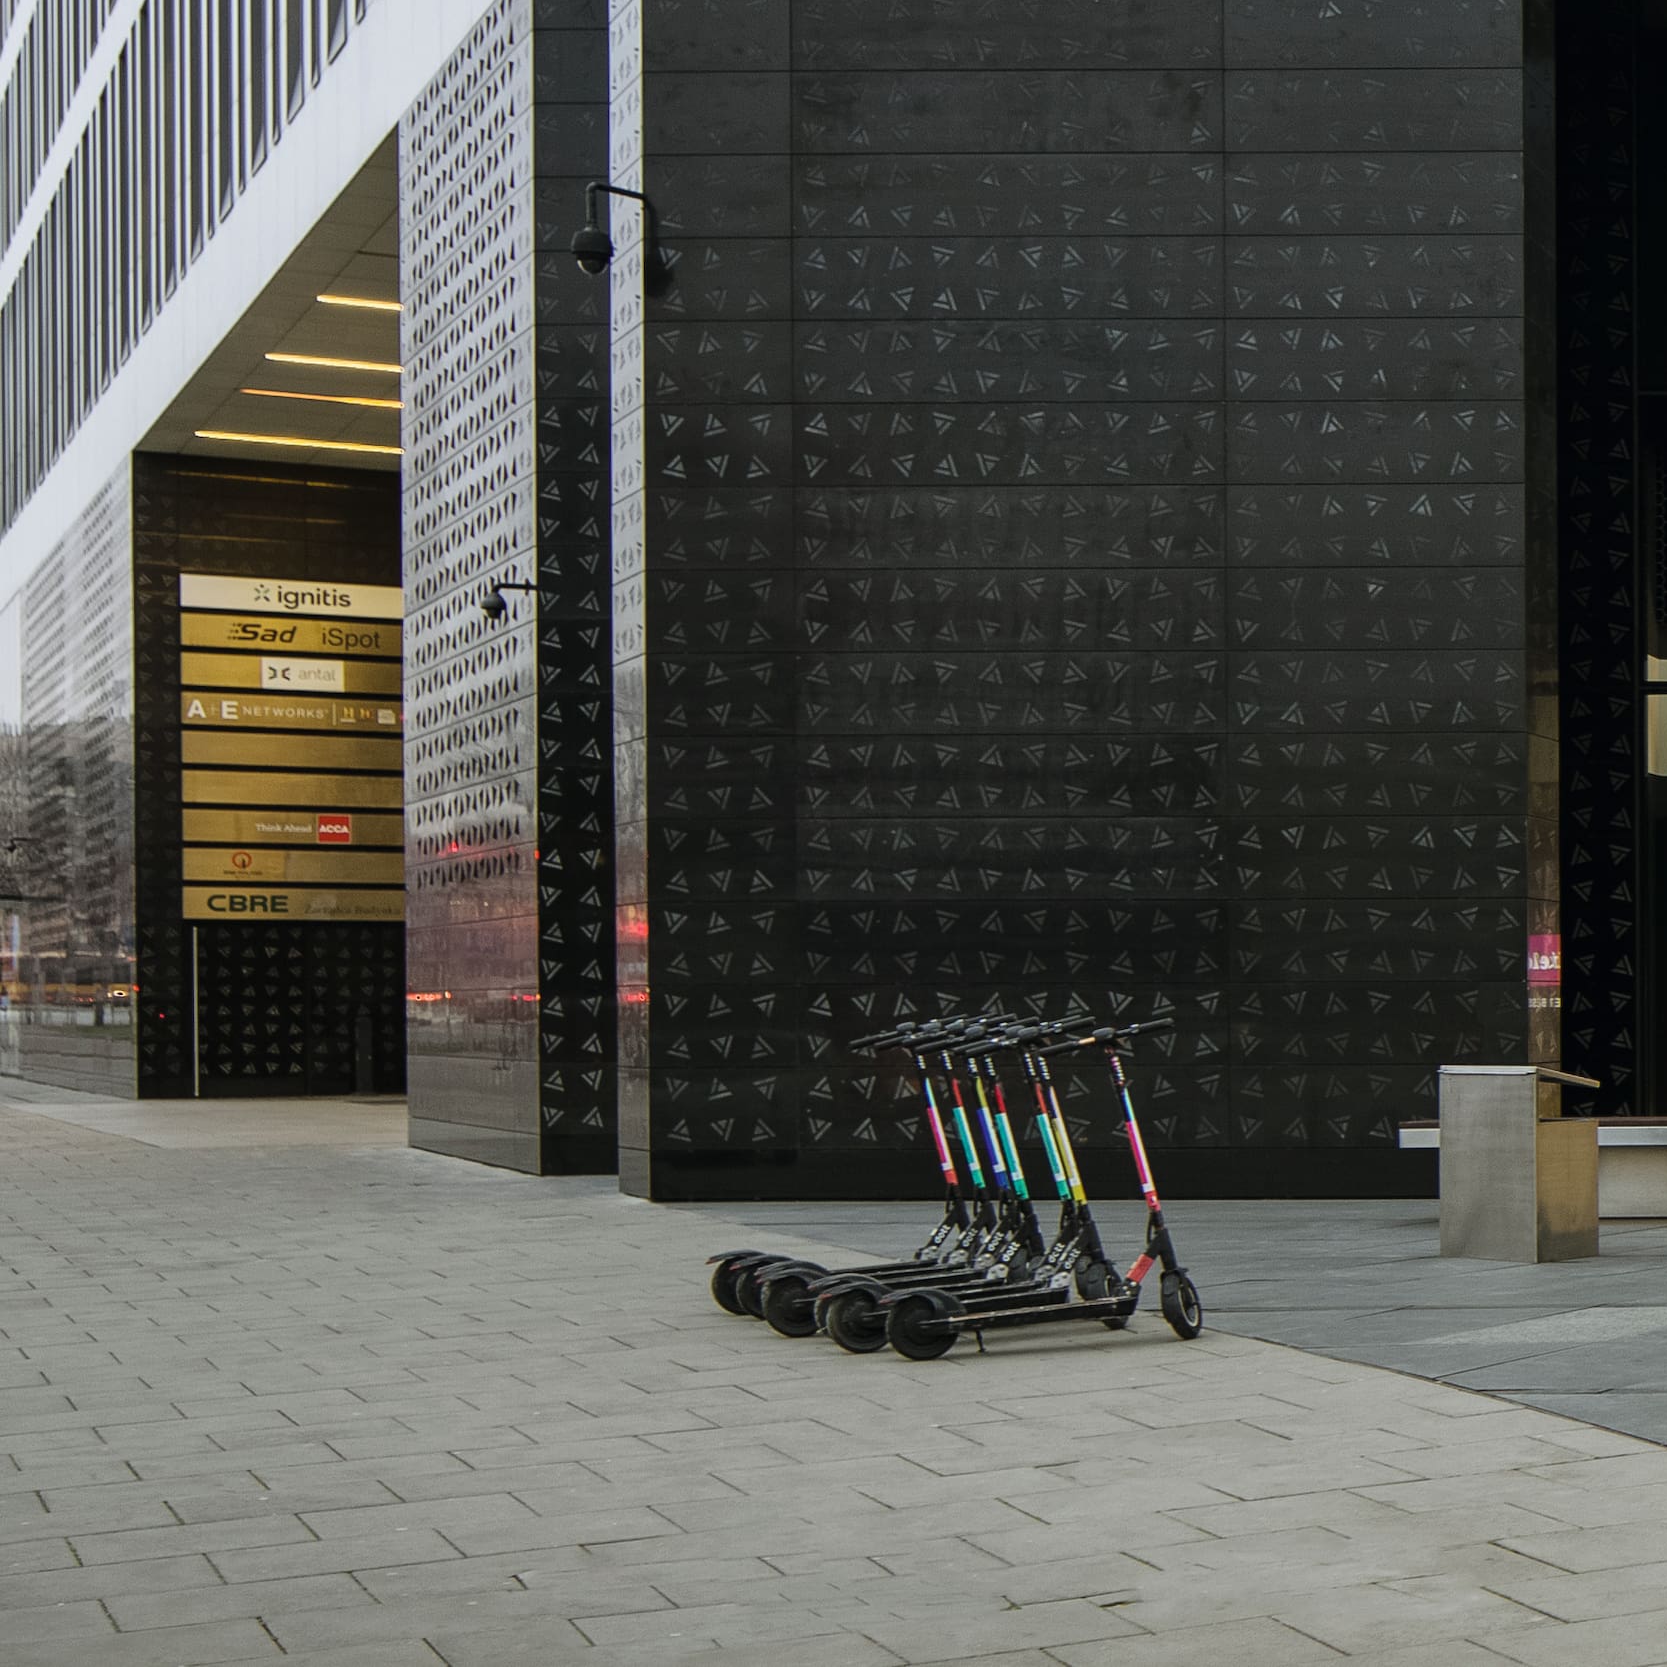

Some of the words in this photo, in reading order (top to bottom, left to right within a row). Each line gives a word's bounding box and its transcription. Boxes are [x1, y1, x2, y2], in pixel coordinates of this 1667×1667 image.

[278, 585, 352, 610] ignitis
[236, 623, 297, 644] Sad
[321, 628, 381, 650] iSpot
[298, 667, 336, 682] antal
[255, 822, 283, 833] Think
[319, 823, 349, 835] ACCA
[207, 894, 289, 913] CBRE
